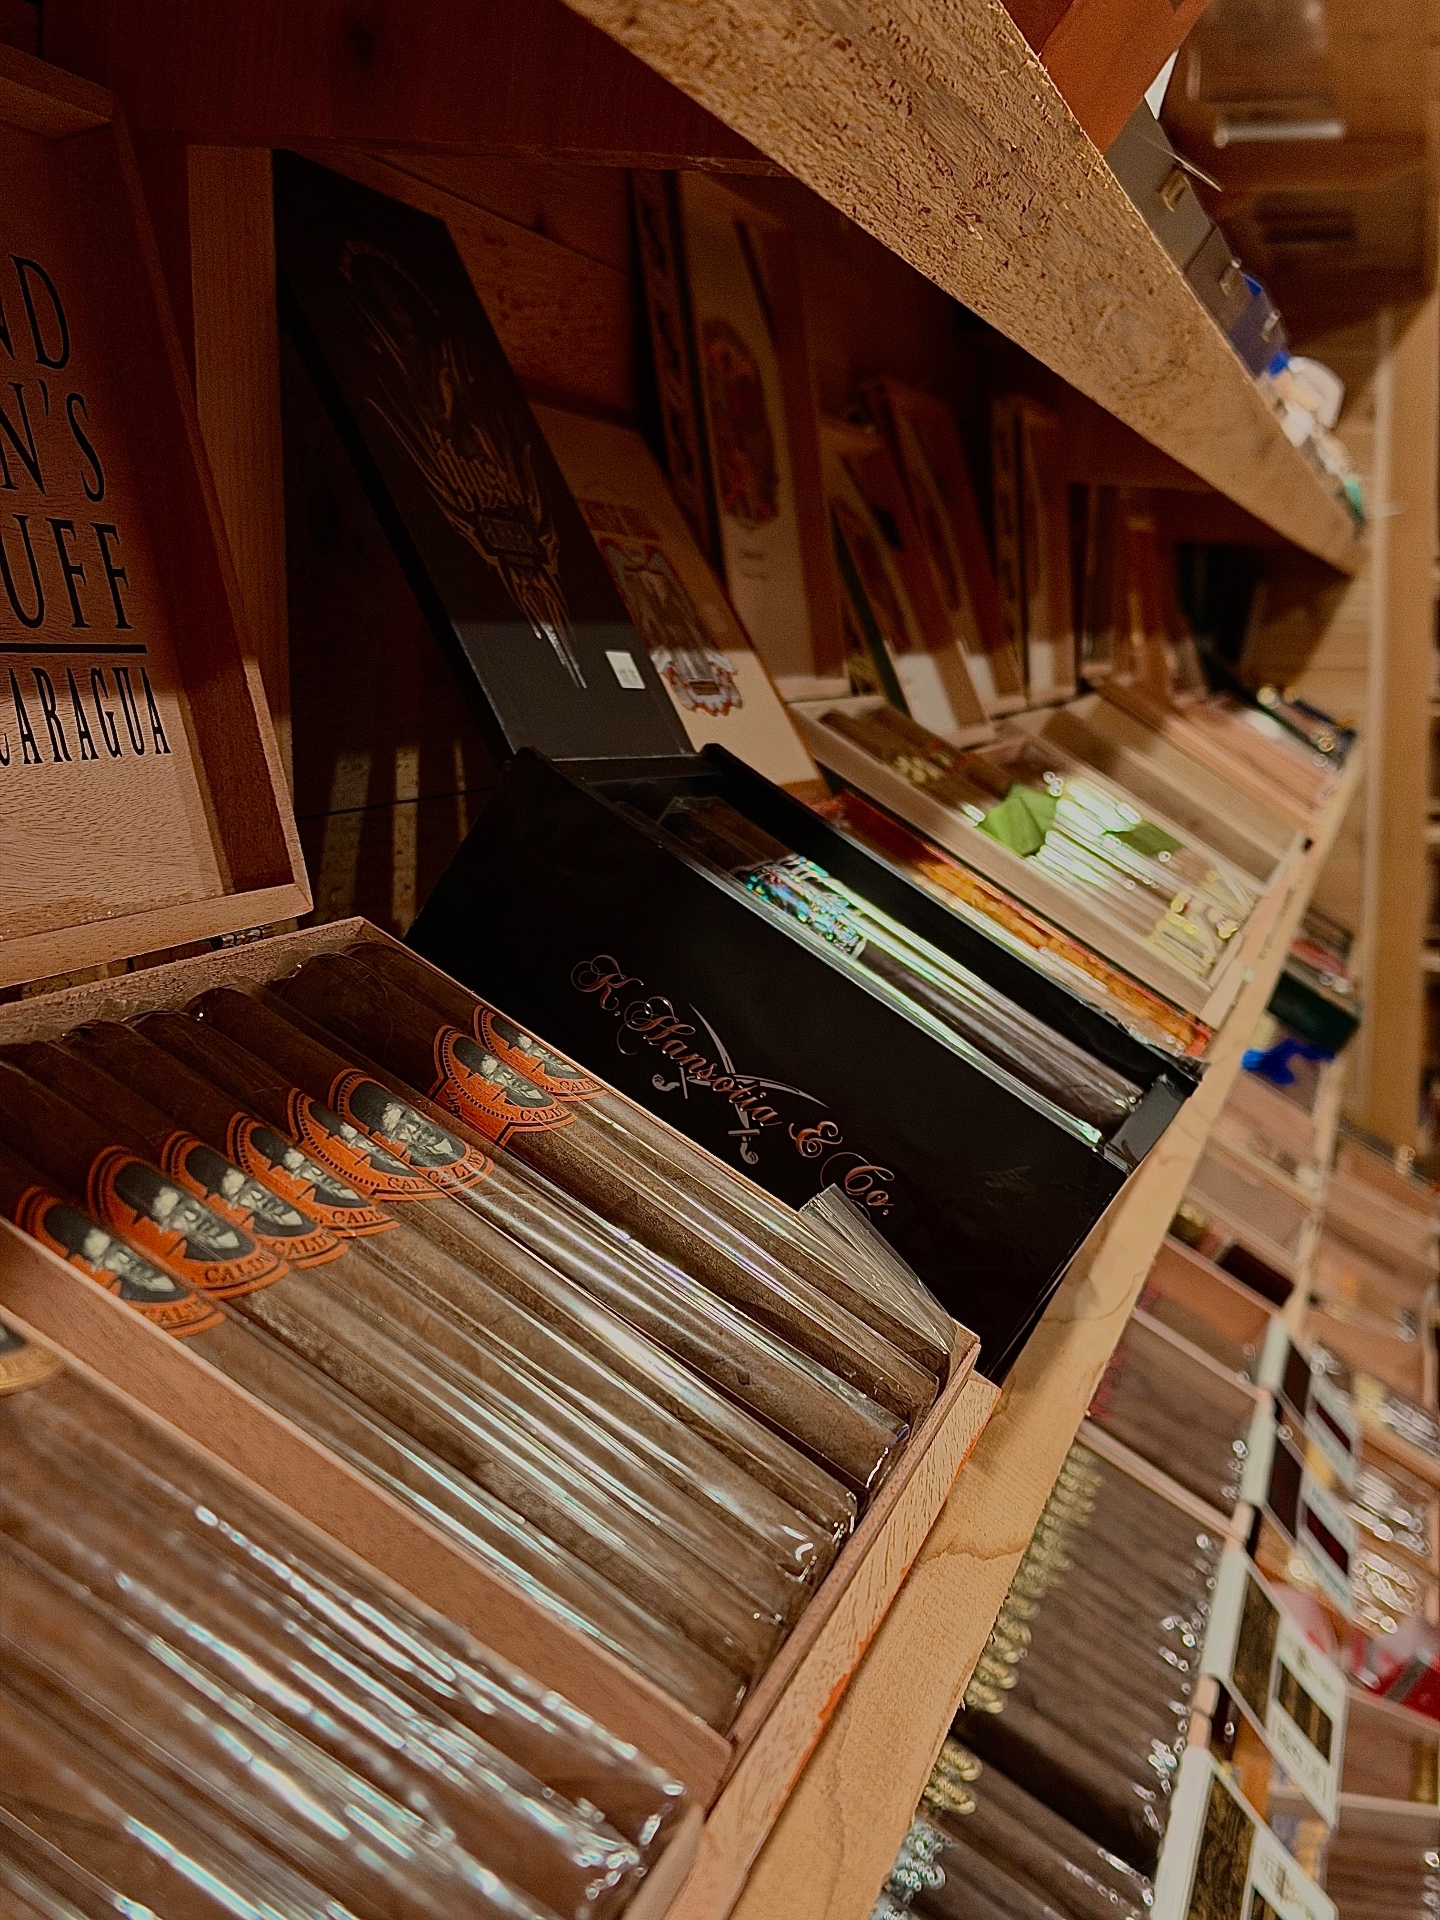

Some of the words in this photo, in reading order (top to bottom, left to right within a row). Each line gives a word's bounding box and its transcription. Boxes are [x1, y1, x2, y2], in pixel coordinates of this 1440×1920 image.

[0, 513, 133, 629] UFF
[571, 955, 643, 1016] K.
[820, 1152, 894, 1220] Co.
